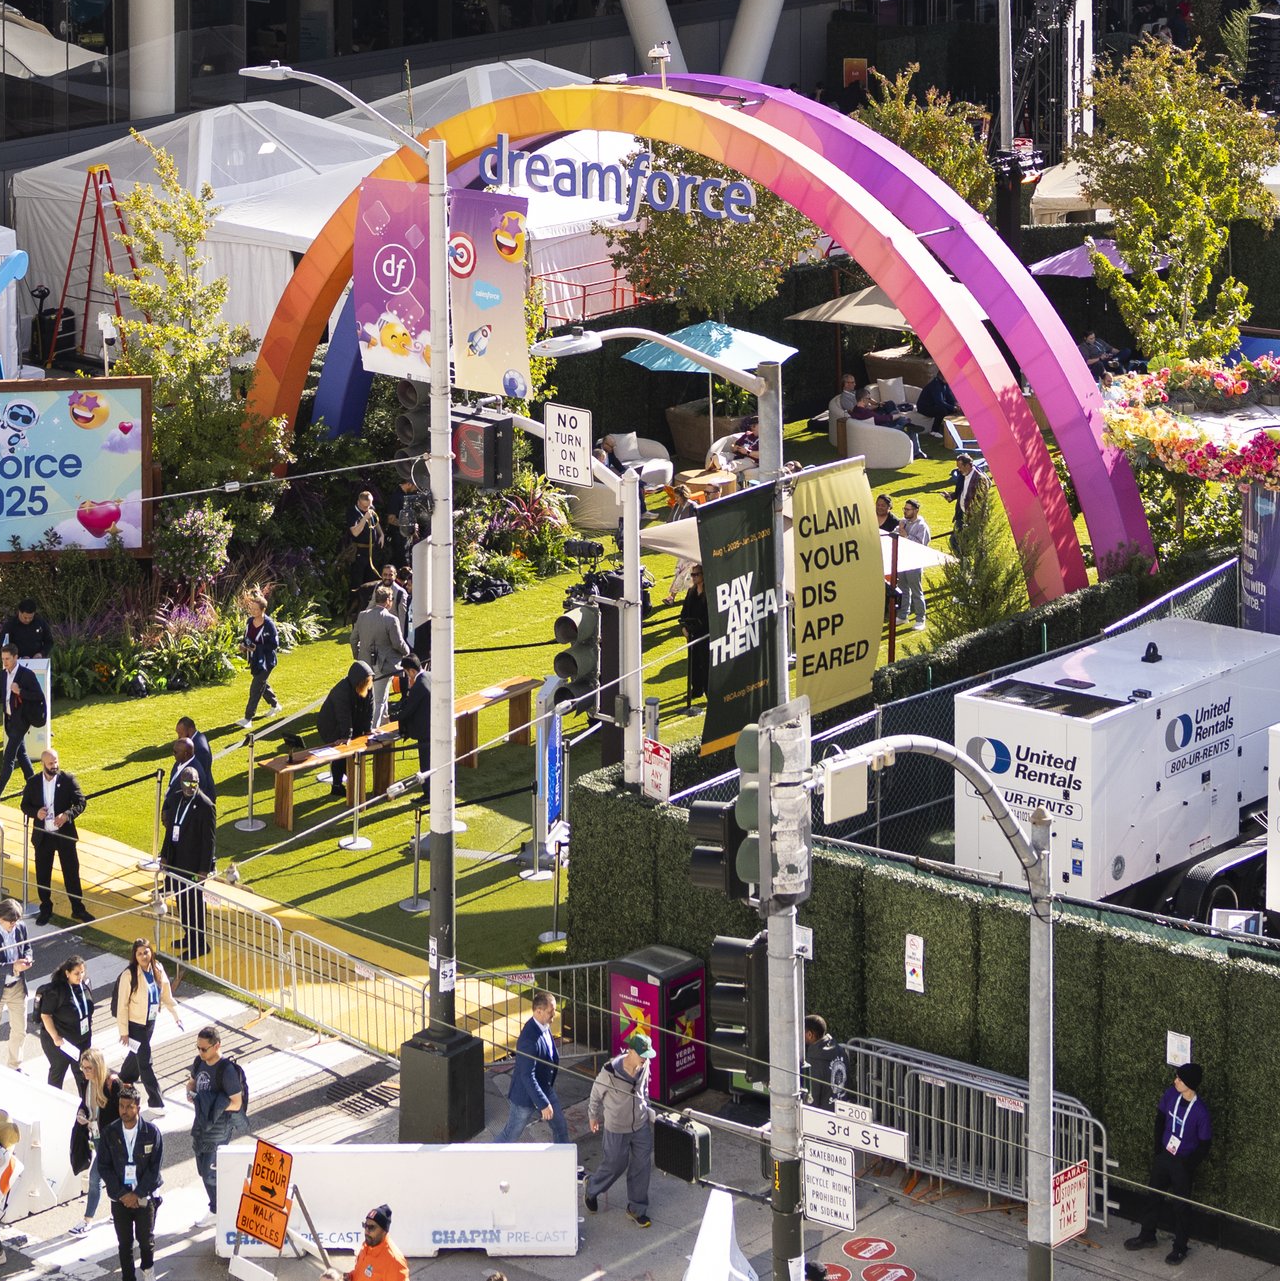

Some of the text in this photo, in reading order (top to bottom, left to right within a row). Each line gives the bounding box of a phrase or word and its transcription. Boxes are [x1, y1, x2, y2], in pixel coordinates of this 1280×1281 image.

[479, 133, 754, 224] dreamforce
[382, 254, 407, 287] df
[475, 290, 500, 302] salesforce
[557, 412, 578, 430] NO
[555, 431, 582, 448] TURN
[560, 449, 576, 462] ON
[558, 464, 579, 479] RED
[798, 503, 861, 539] CLAIM
[712, 548, 723, 558] Aug
[799, 539, 860, 573] YOUR
[716, 571, 754, 613] BAY
[801, 580, 837, 608] DIS
[726, 588, 778, 635] AREA
[801, 613, 844, 644] APP
[709, 622, 760, 667] THEN
[802, 639, 869, 677] EARED
[1194, 696, 1232, 725] United
[1193, 715, 1234, 743] Rentals
[1015, 745, 1078, 771] United
[1170, 738, 1230, 774] 800-UR-RENTS
[651, 769, 663, 783] ANY
[651, 779, 662, 793] TIME
[1014, 762, 1082, 791] Rentals
[675, 1045, 696, 1060] YERBA
[675, 1053, 696, 1068] BUENA
[997, 1095, 1023, 1108] NATIONAL
[848, 1107, 867, 1120] 200
[827, 1120, 880, 1149] 3rd St
[809, 1148, 847, 1166] SKATEBOARD
[254, 1163, 287, 1189] DETOUR
[822, 1166, 835, 1177] AND
[1054, 1161, 1087, 1186] OW-AWAY
[806, 1174, 851, 1196] BICYCLE RIDING
[1061, 1177, 1086, 1200] STOPPING
[811, 1189, 847, 1208] PROHIBITED
[1060, 1197, 1076, 1216] ANY
[252, 1204, 275, 1223] WALK
[810, 1203, 850, 1221] ON SIDEWALK
[1059, 1210, 1077, 1230] TIME
[240, 1215, 279, 1243] BICYCLES
[301, 1231, 362, 1245] PRE-CAST
[431, 1229, 568, 1244] CHAPIN PRE-CAST
